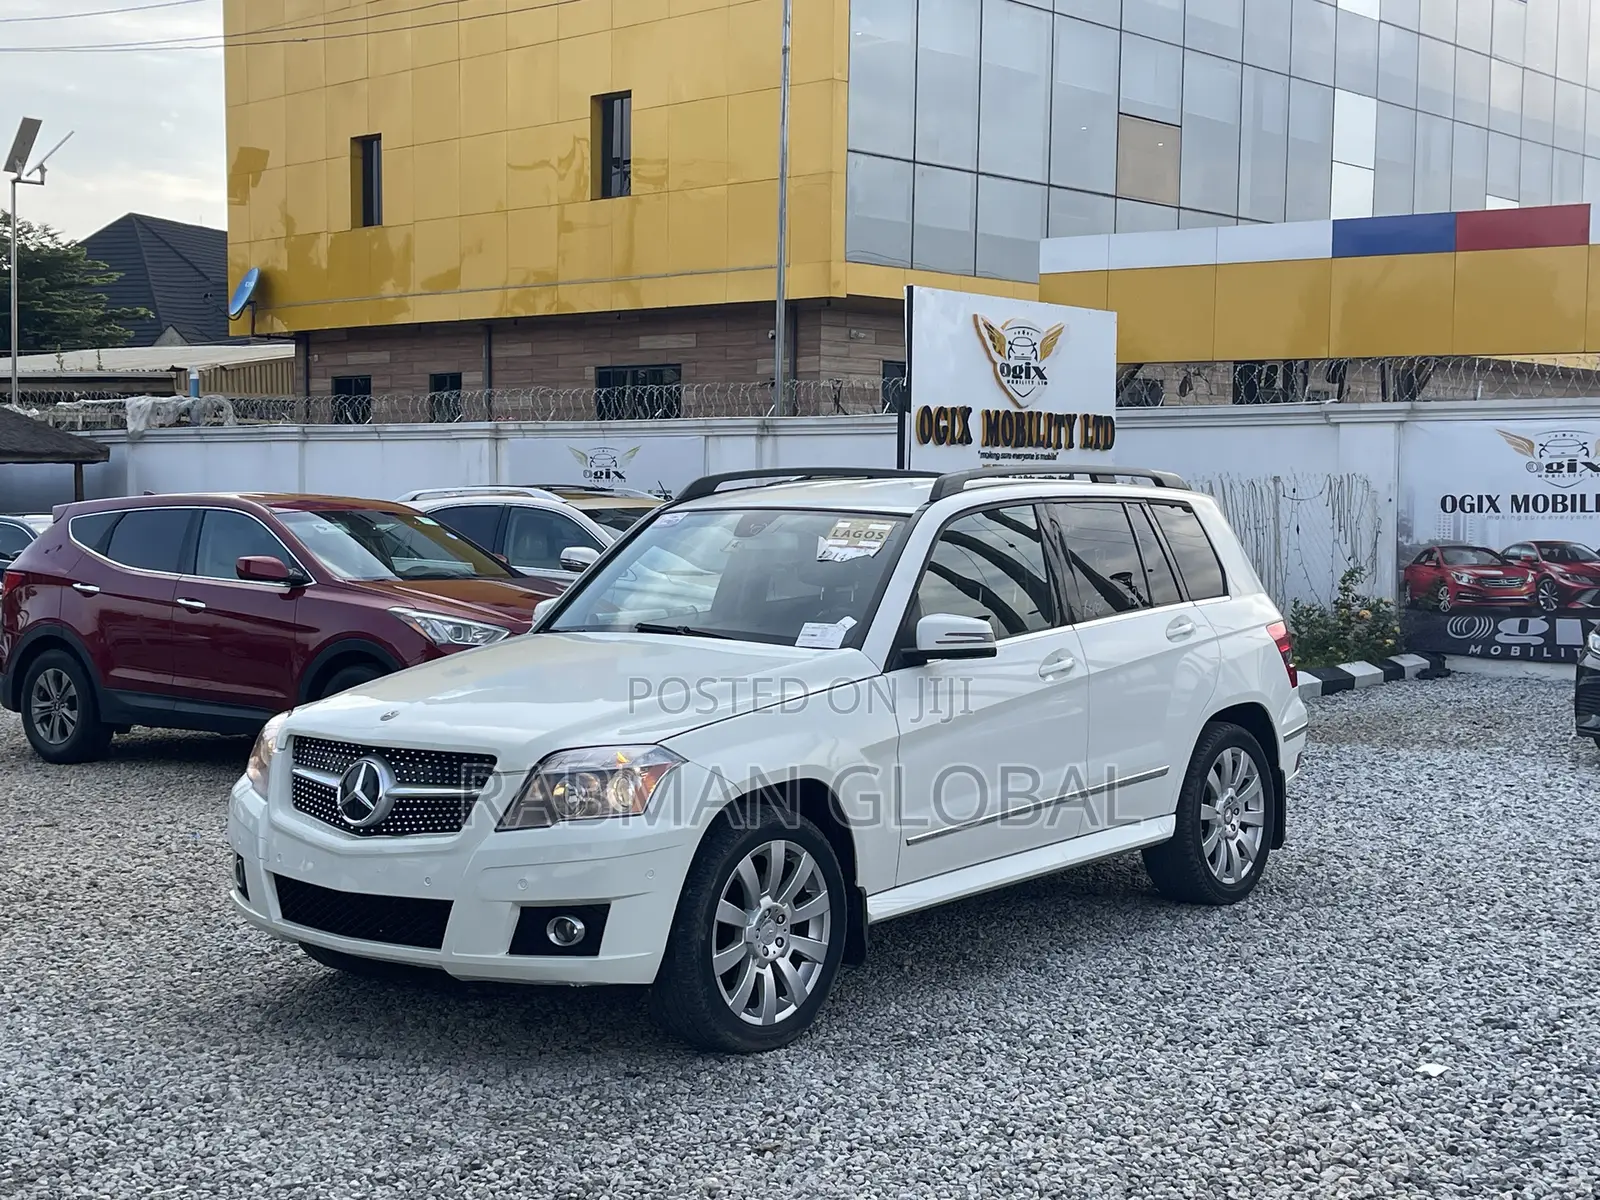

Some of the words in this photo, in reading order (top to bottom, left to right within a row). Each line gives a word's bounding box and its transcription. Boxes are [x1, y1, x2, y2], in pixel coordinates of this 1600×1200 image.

[916, 405, 973, 446] OGIX
[981, 409, 1077, 450] MOBILITY
[1080, 413, 1115, 450] LTD
[1440, 494, 1501, 514] OGIX
[832, 529, 885, 540] LAGOS
